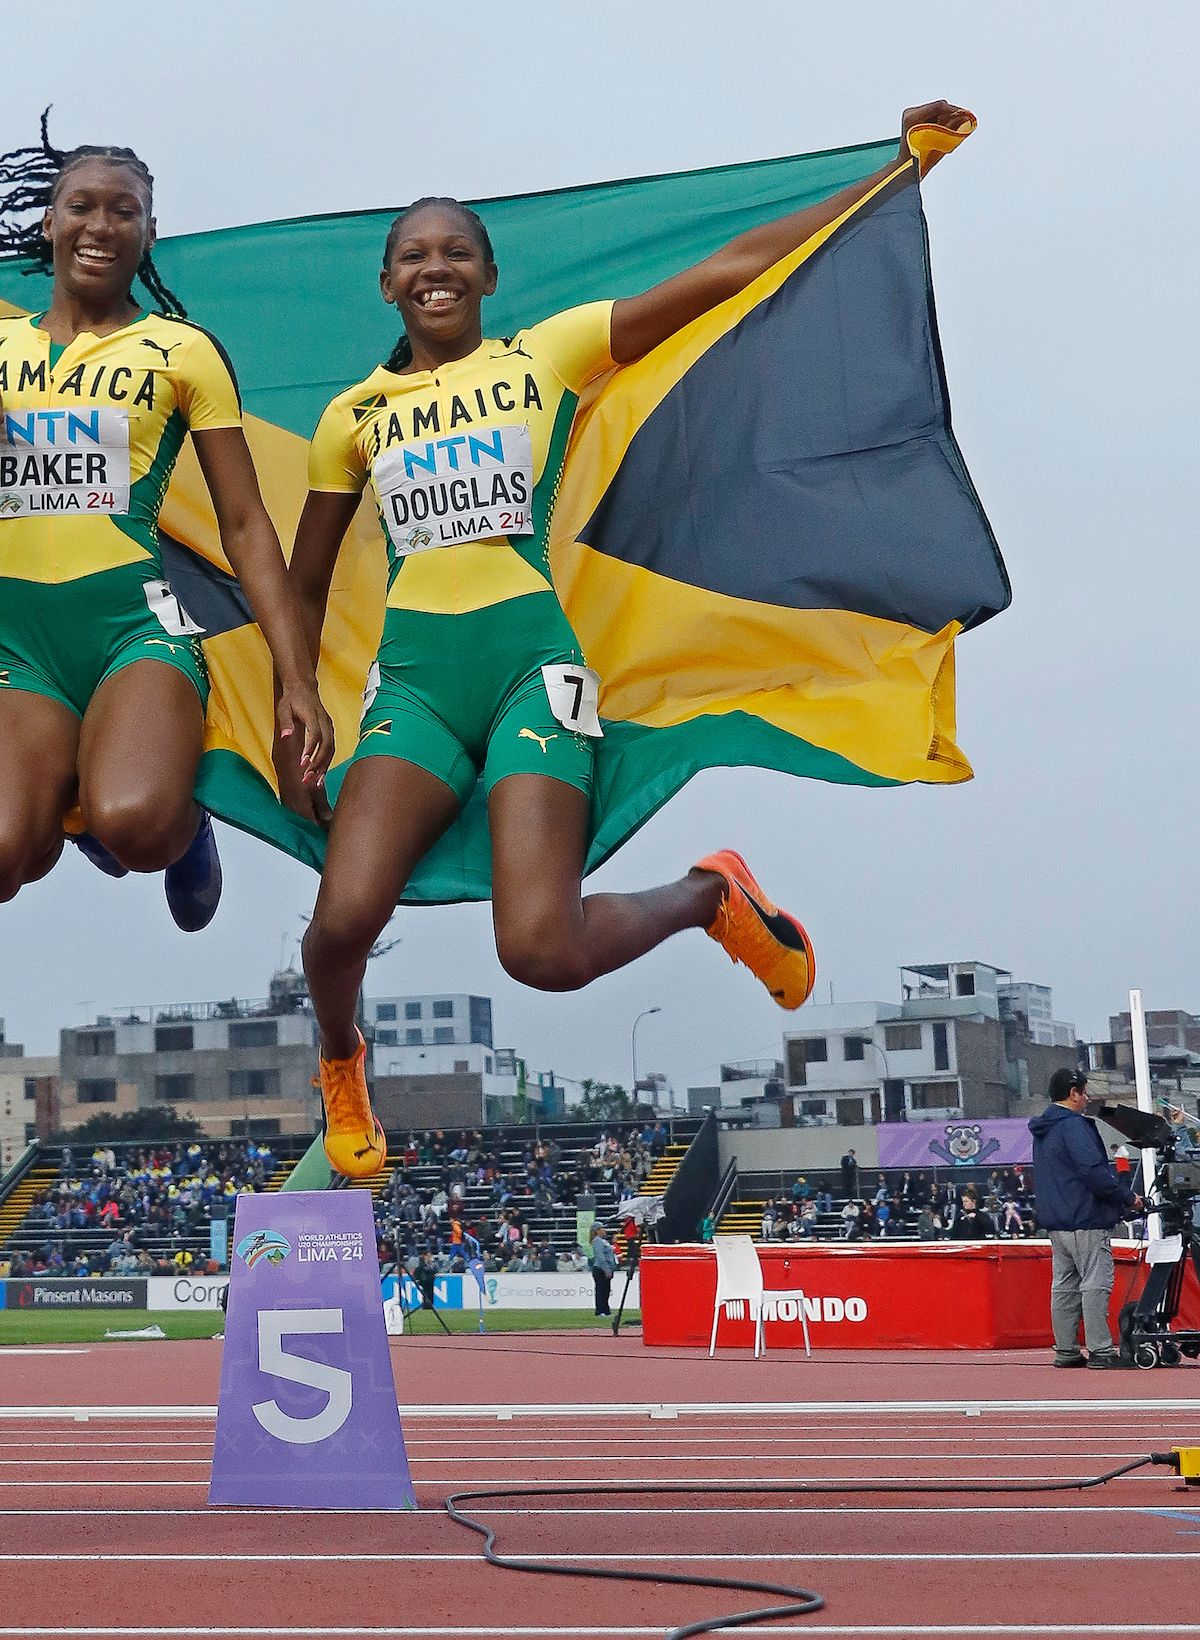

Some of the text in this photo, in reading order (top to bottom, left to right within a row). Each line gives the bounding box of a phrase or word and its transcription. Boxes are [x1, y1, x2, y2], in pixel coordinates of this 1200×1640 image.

[5, 410, 100, 448] NTN
[373, 373, 543, 458] JAMAICA
[402, 430, 505, 481] NTN
[0, 453, 107, 488] BAKER
[29, 492, 115, 511] LIMA 24
[390, 471, 528, 527] DOUGLAS
[438, 512, 525, 541] LIMA 24
[562, 675, 584, 721] 7
[298, 1232, 363, 1242] WORLD ATHLETICS
[311, 1240, 363, 1248] CHAMPIONSHIPS
[298, 1246, 363, 1262] LIMA 24
[33, 1287, 134, 1304] Pinsent Masons
[535, 1286, 576, 1297] Ricardo
[749, 1297, 869, 1323] MONDO
[251, 1308, 354, 1444] 5
